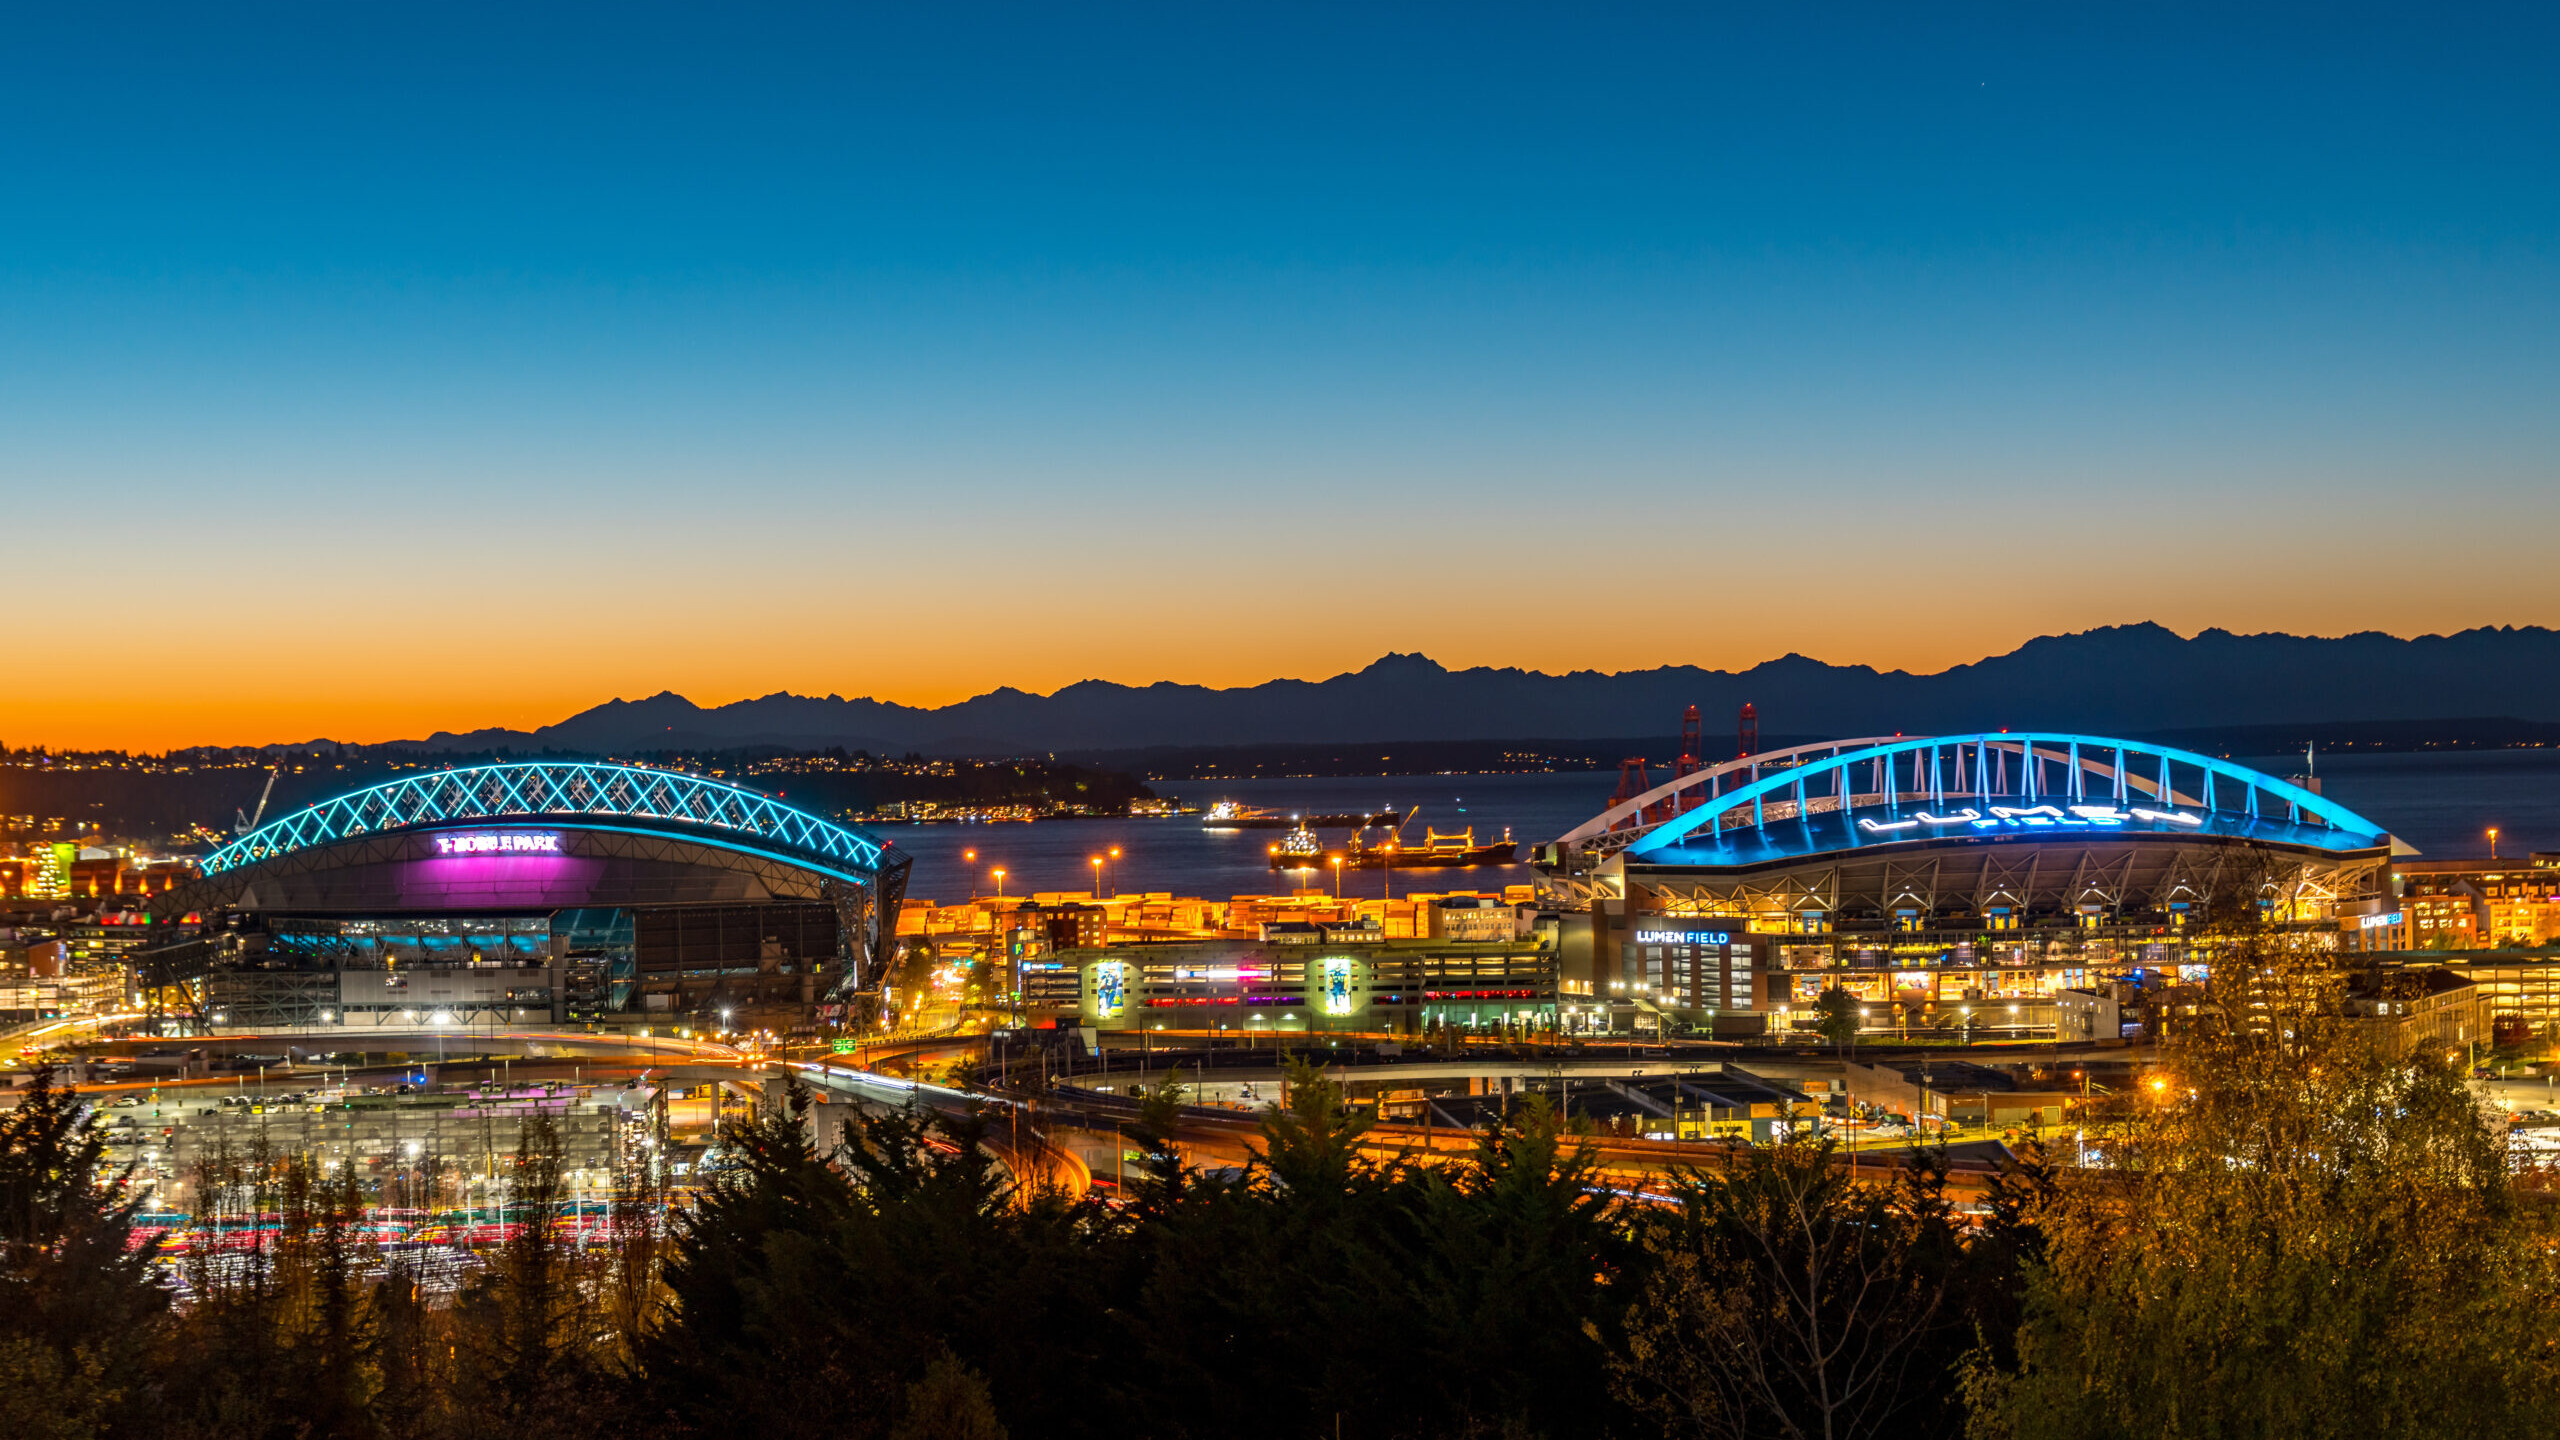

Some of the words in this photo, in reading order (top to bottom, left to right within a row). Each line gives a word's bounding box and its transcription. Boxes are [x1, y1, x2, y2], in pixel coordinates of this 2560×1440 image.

[513, 835, 558, 851] PARK
[1636, 930, 1685, 943] LUMEN
[1686, 931, 1729, 945] FIELD
